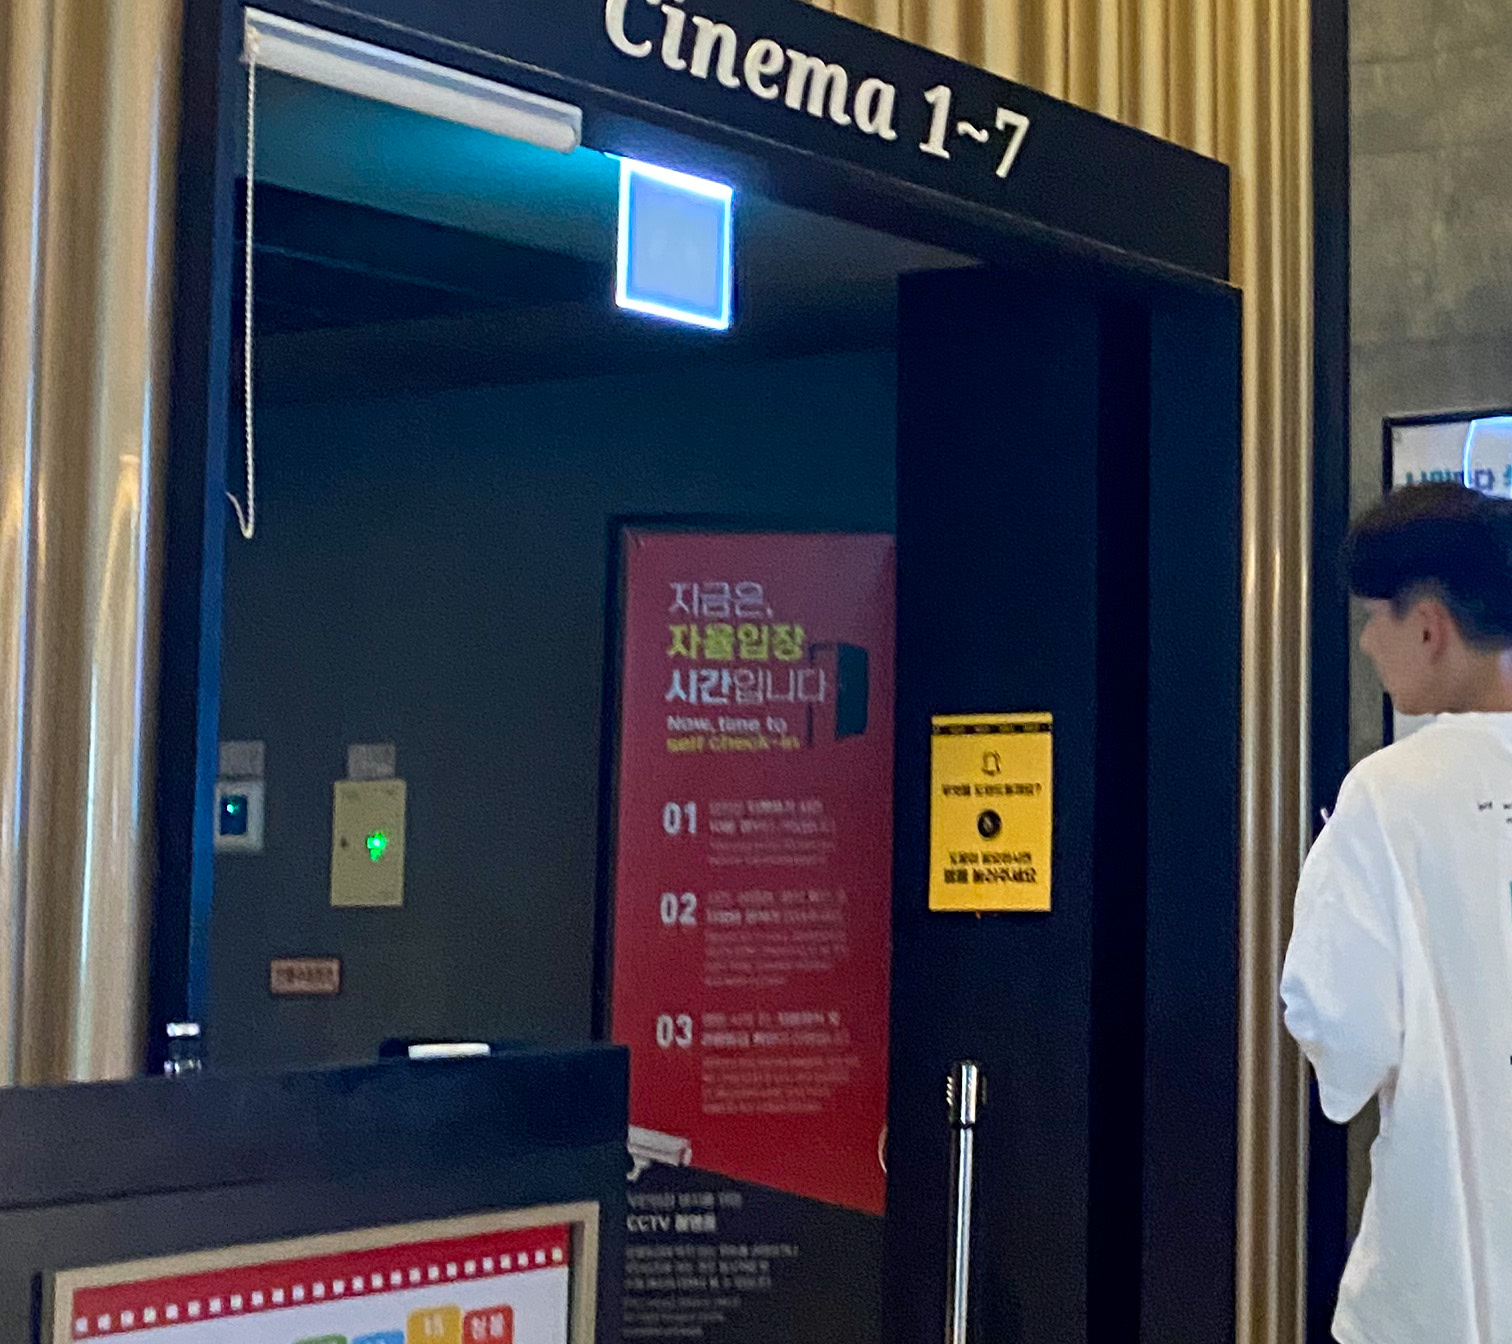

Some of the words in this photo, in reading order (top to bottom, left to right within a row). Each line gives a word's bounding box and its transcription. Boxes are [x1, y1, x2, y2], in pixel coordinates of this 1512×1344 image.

[918, 84, 1030, 178] 1~7
[668, 580, 774, 619] 지금은,
[664, 666, 827, 706] 시간입니다
[662, 801, 698, 834] 01
[659, 891, 698, 925] 02
[656, 1013, 694, 1048] 03
[626, 1214, 671, 1233] CCTV
